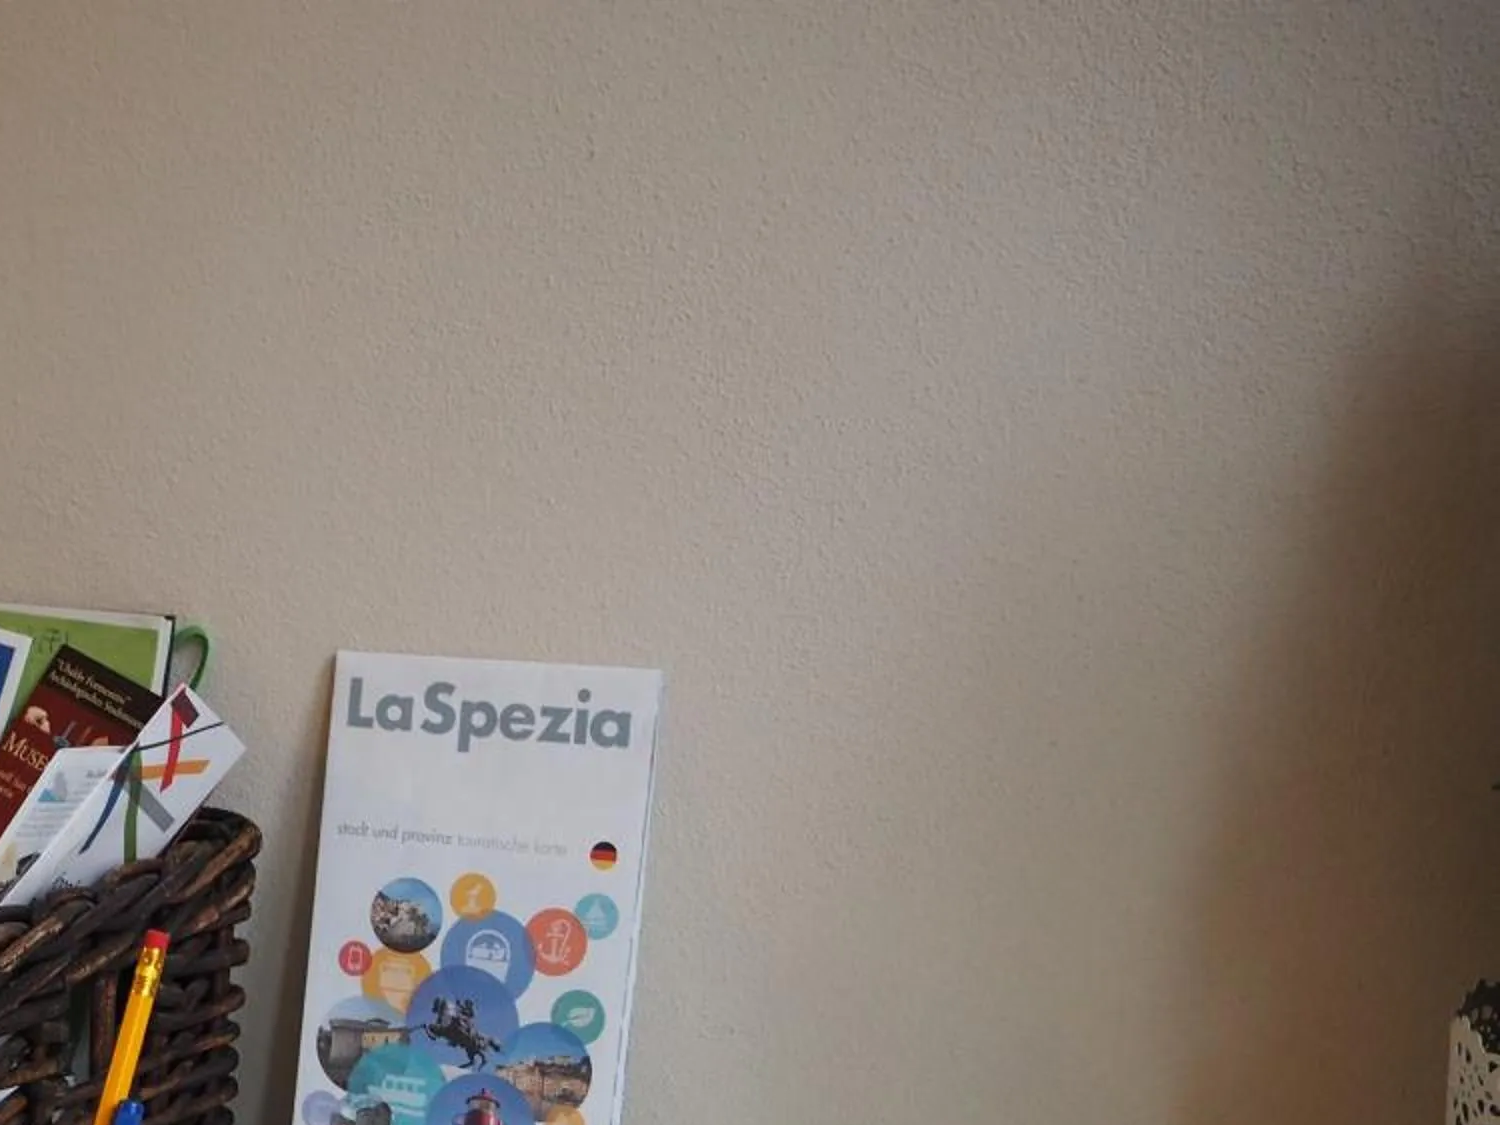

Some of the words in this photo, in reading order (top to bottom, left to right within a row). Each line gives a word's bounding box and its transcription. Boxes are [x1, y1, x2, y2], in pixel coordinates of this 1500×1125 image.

[1, 731, 49, 771] MUSE
[372, 825, 398, 841] und
[401, 828, 453, 846] provinz
